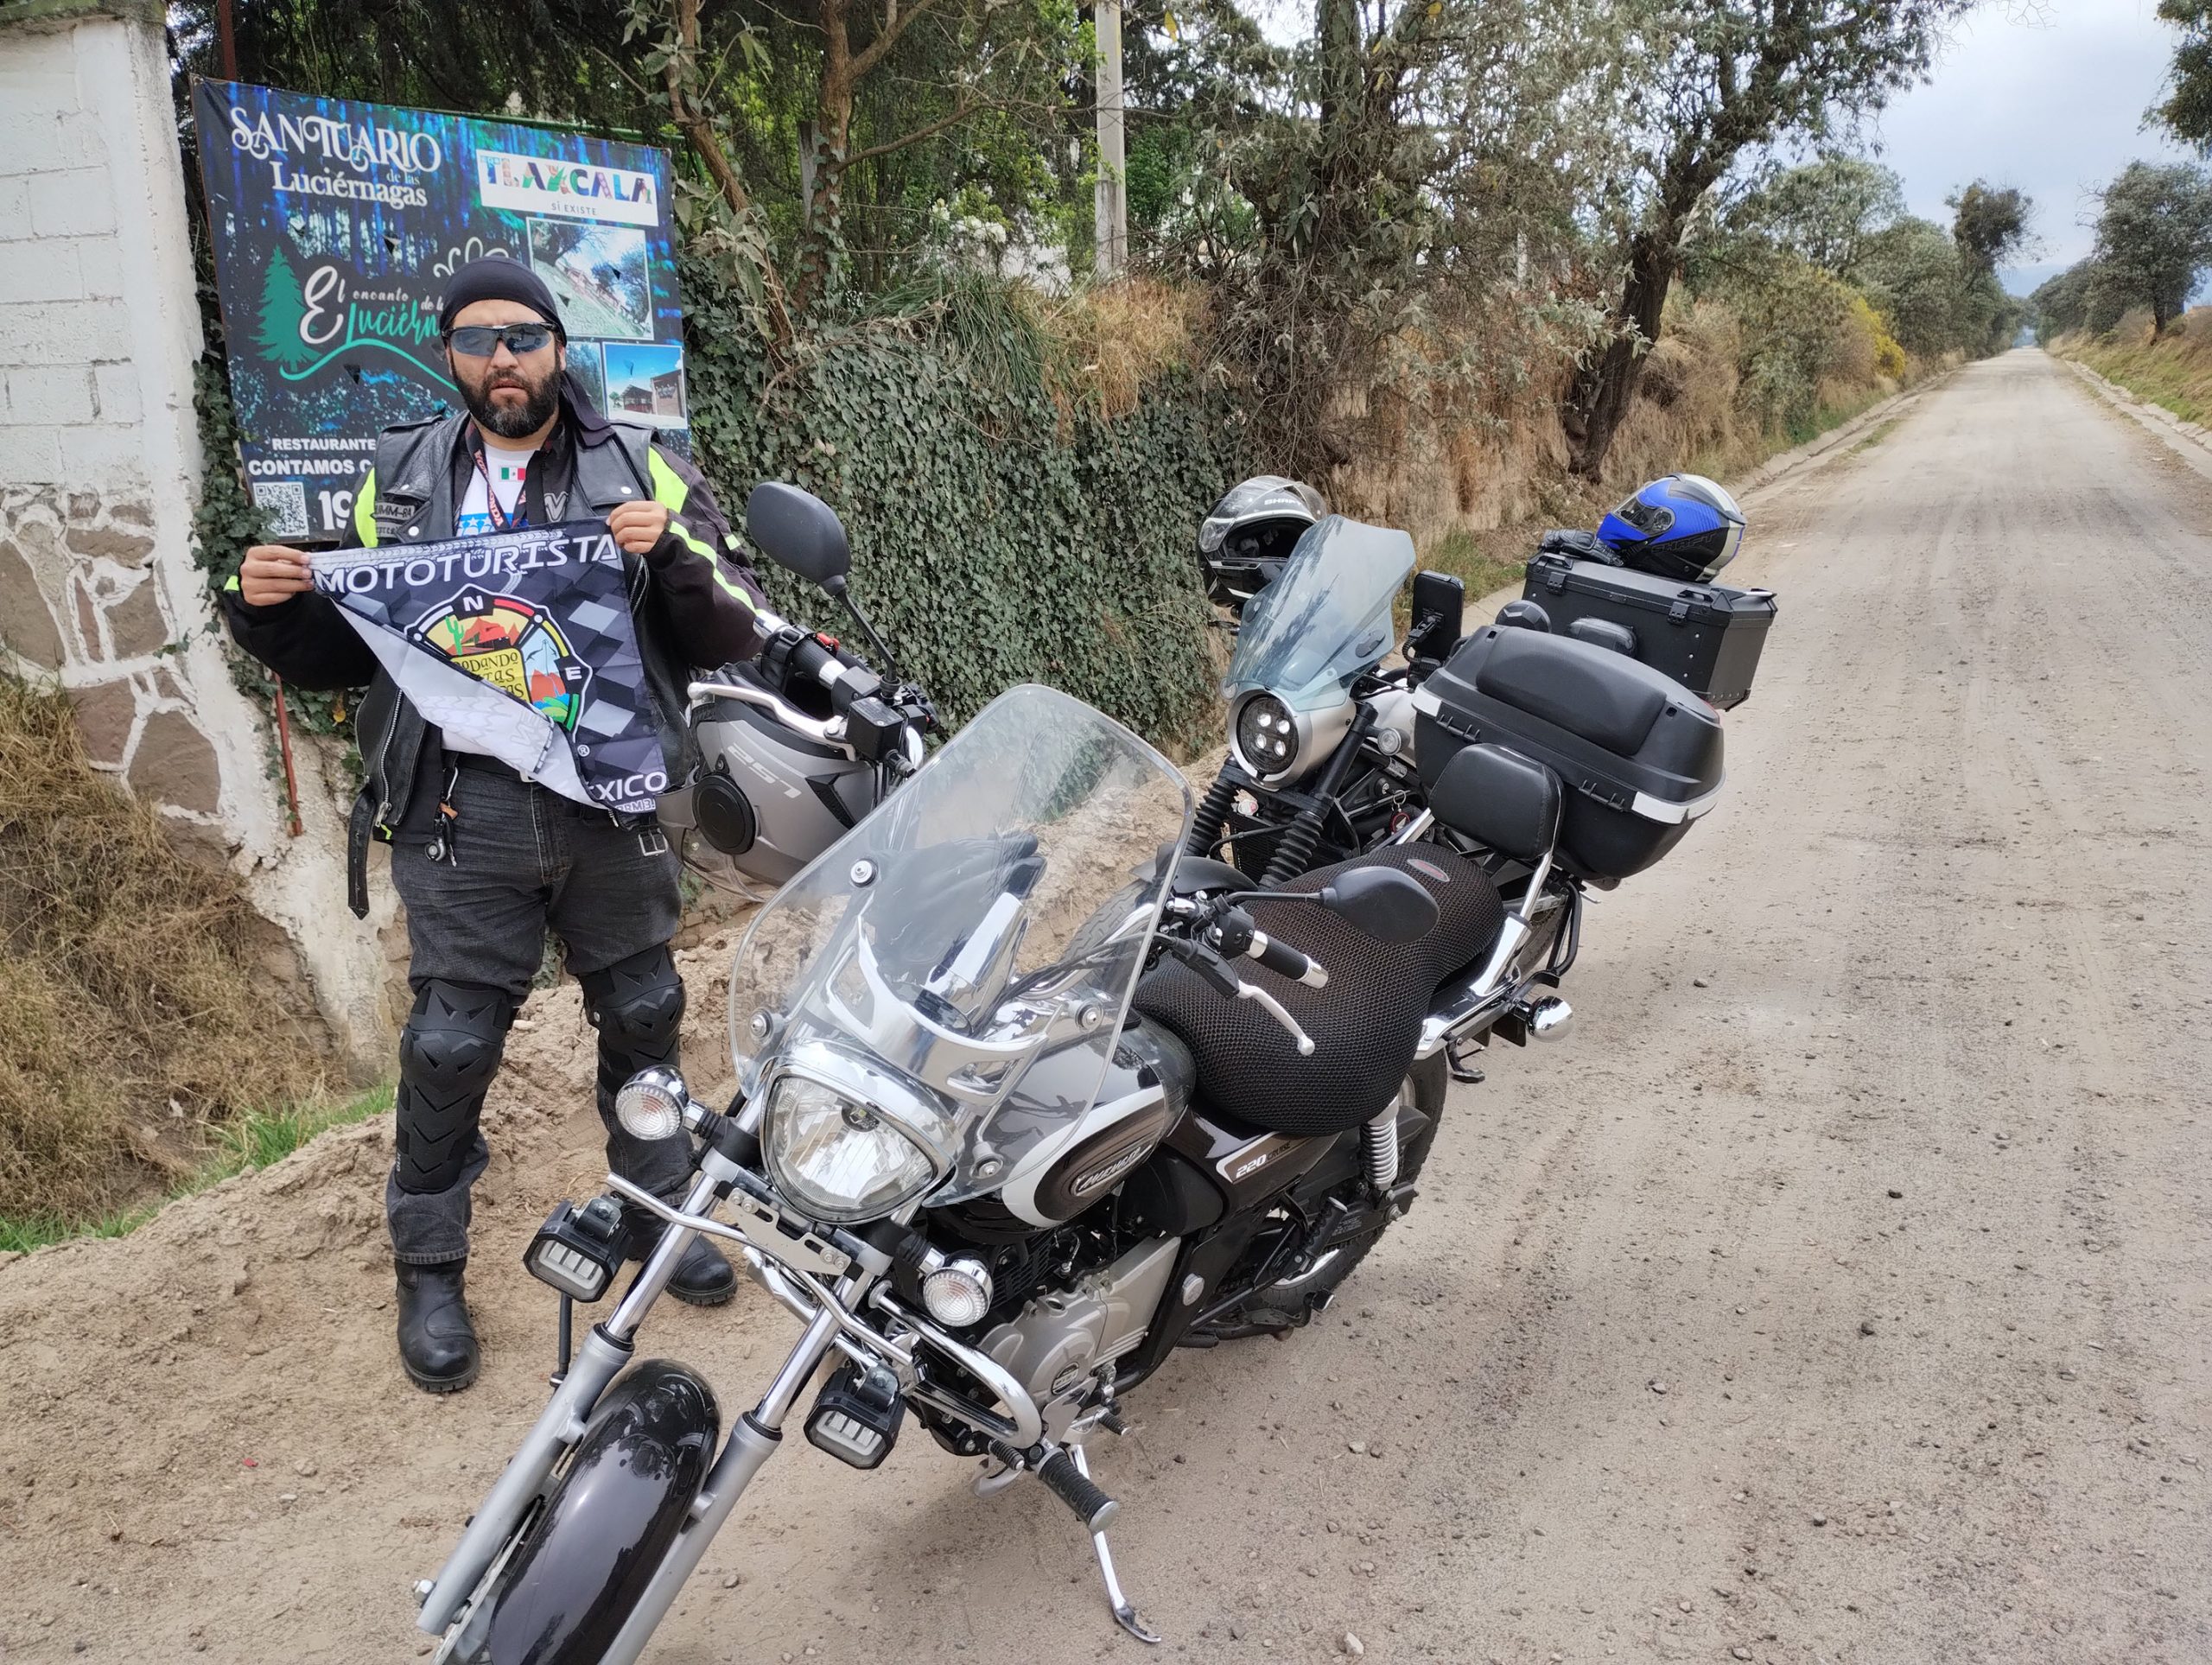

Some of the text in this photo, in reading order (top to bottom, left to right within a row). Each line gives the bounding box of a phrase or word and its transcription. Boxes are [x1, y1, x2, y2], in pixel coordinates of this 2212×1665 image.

[230, 106, 442, 172] SANTUARIO
[269, 161, 428, 210] Luciérnagas
[386, 169, 421, 185] de las
[480, 156, 652, 204] TLAXCALA
[564, 207, 597, 216] EXISTE
[353, 287, 410, 302] encanto
[421, 295, 434, 311] de
[346, 298, 441, 346] Luciérn
[271, 438, 376, 451] RESTAURANTE
[248, 459, 356, 476] CONTAMOS
[313, 533, 619, 594] MOTOTURISTA
[462, 594, 485, 612] N
[565, 666, 583, 681] E
[589, 771, 668, 802] XICO
[1236, 1153, 1267, 1179] 220
